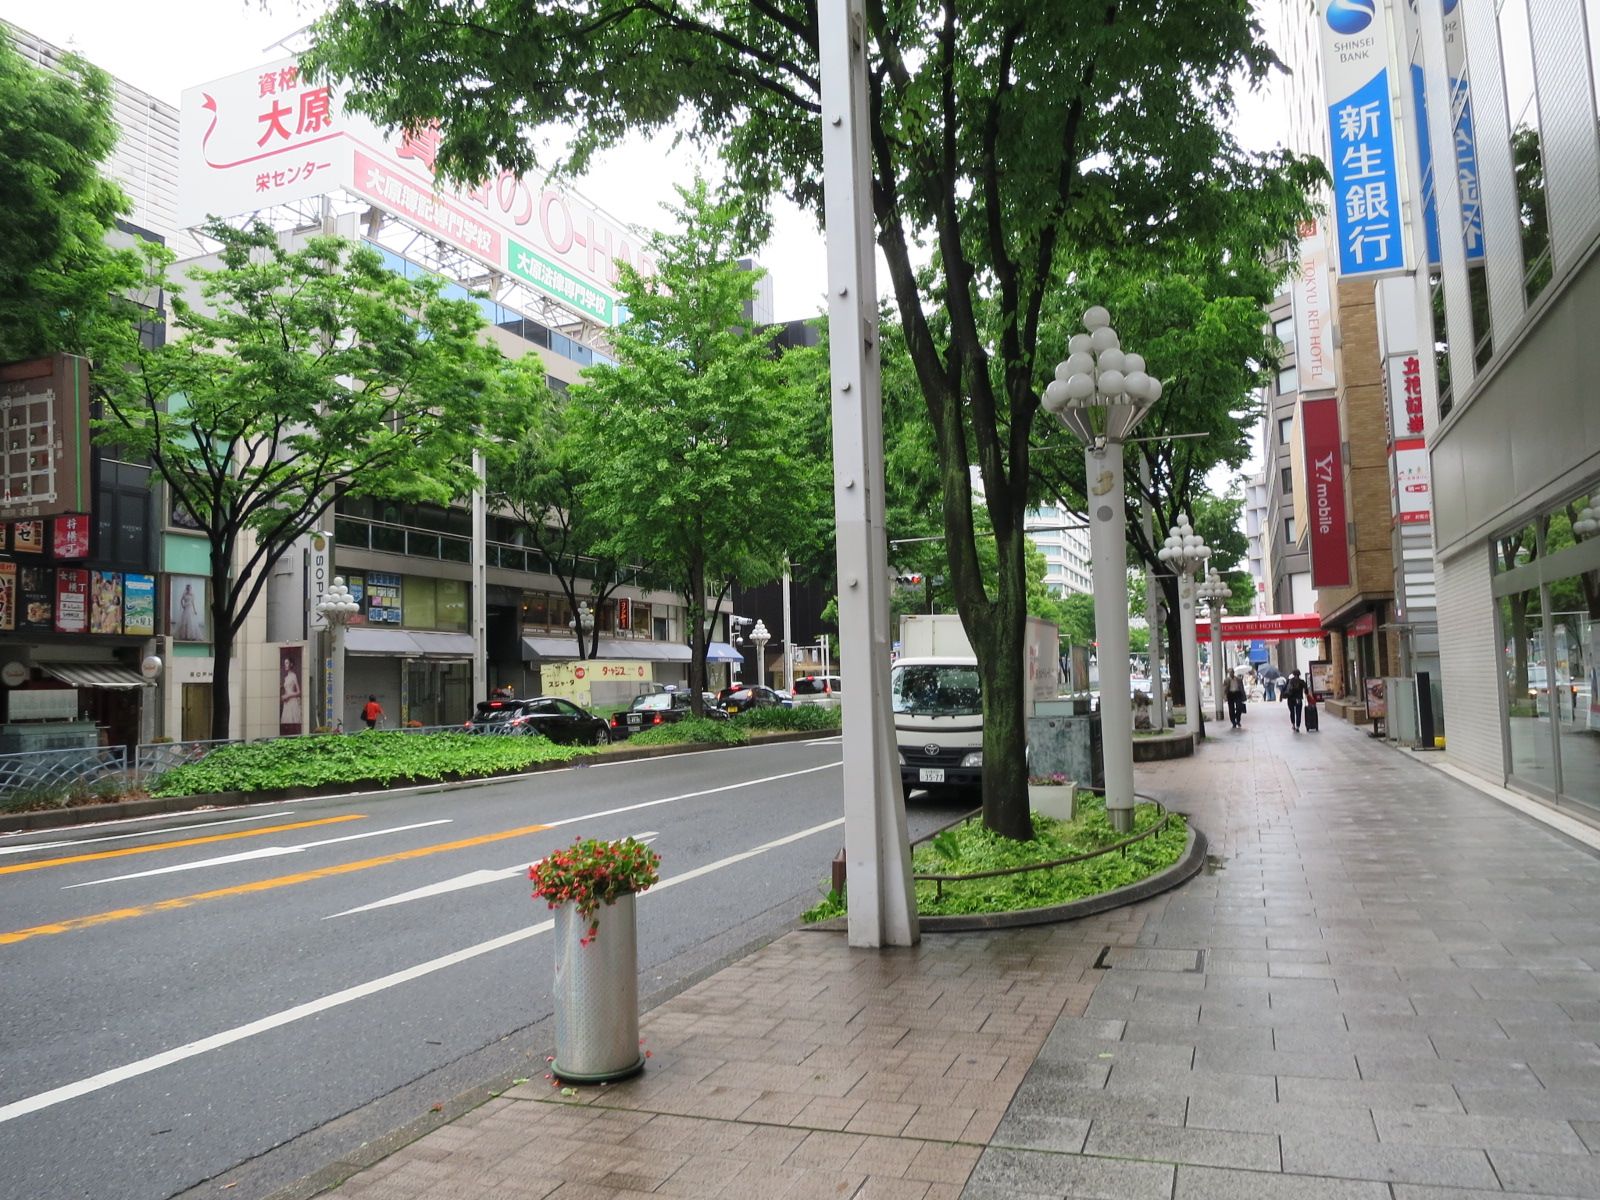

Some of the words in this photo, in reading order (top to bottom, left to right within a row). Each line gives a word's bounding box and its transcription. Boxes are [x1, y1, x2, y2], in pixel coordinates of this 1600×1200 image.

[1333, 37, 1375, 53] SHINSEI
[1340, 50, 1369, 63] BANK
[257, 86, 333, 148] 大原
[256, 161, 331, 192] 栄センター
[1339, 100, 1391, 264] 新生銀行
[1304, 258, 1318, 305] TOKYU
[1308, 310, 1320, 332] REI
[1310, 335, 1323, 382] HOTEL
[315, 555, 324, 622] SOPHA
